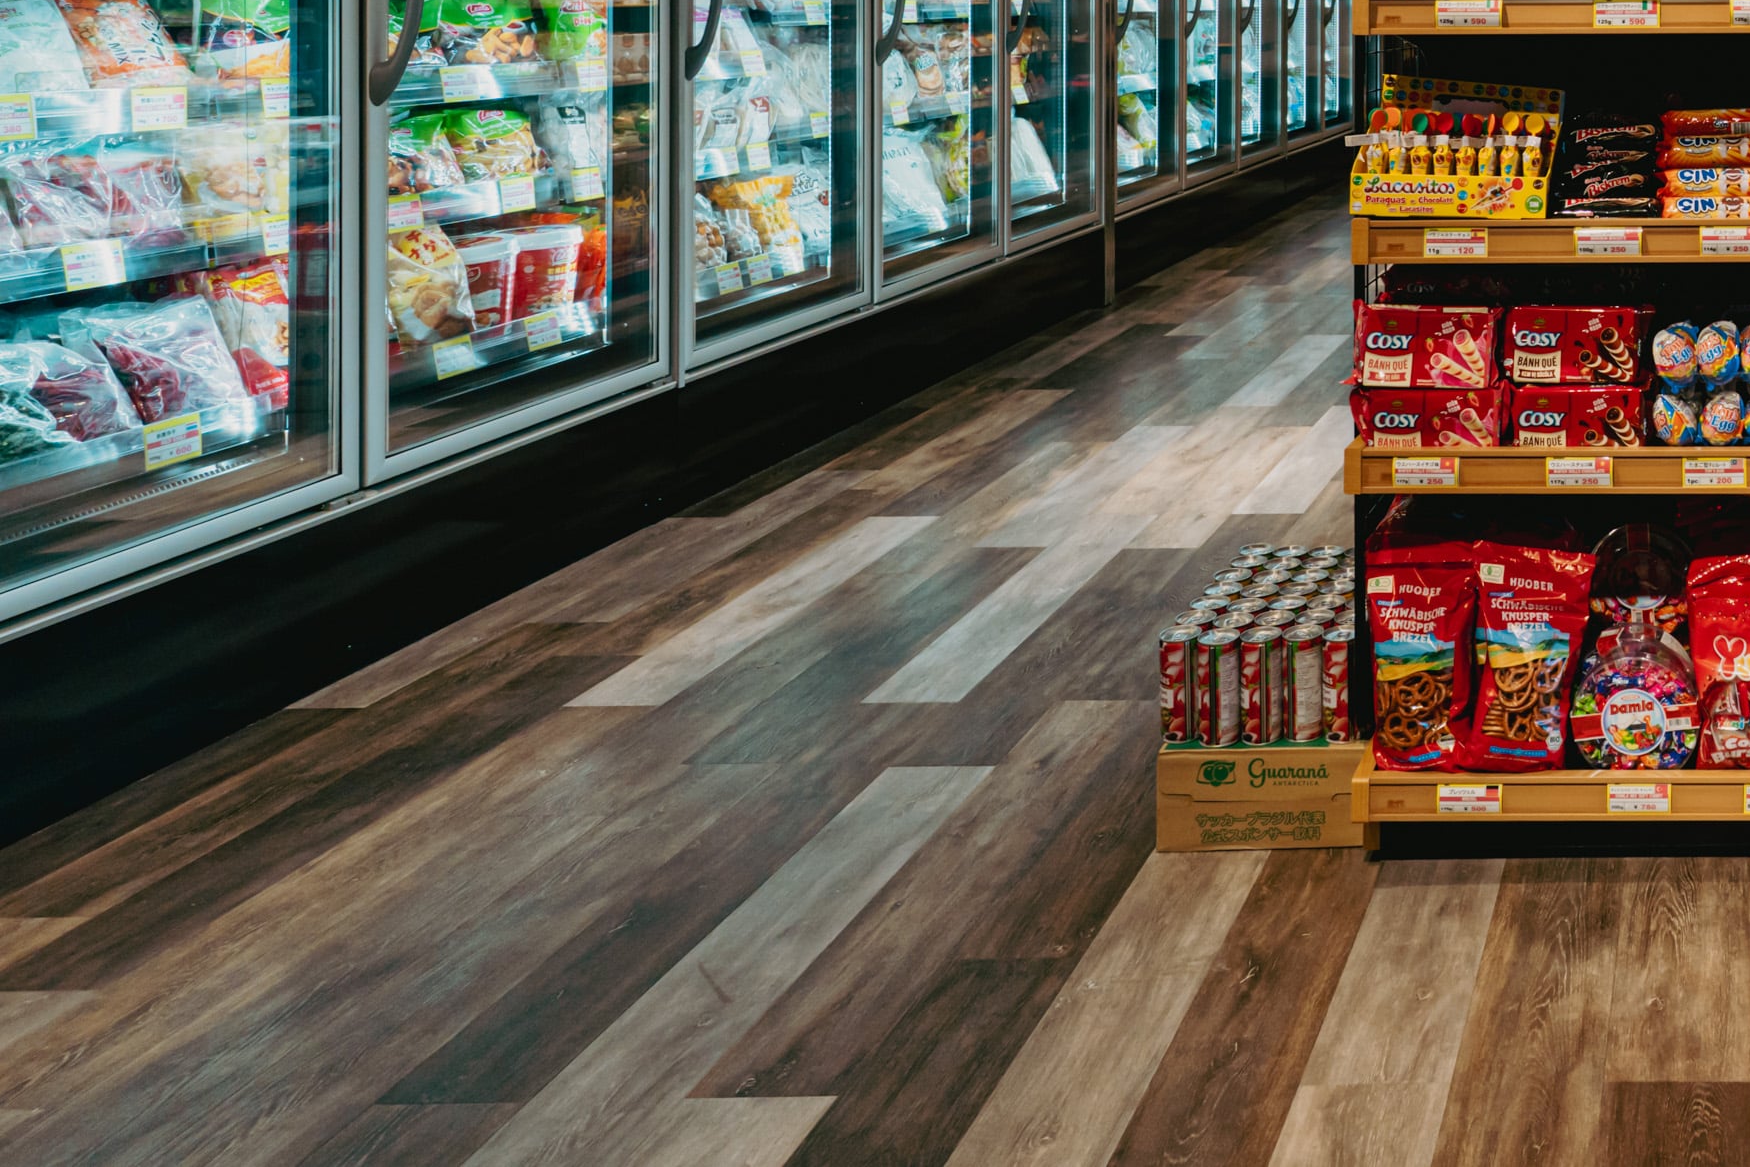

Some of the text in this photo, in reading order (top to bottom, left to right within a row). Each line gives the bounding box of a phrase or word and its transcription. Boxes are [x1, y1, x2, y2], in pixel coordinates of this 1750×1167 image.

[1470, 17, 1487, 25] 590
[1629, 17, 1645, 25] 590
[1363, 177, 1455, 195] Lacasitos
[1365, 195, 1454, 207] Paraguas Chocolate
[1366, 332, 1414, 349] COSY
[1515, 330, 1561, 347] COSY
[1373, 411, 1420, 428] COSY
[1519, 410, 1566, 427] COSY
[1426, 477, 1443, 485] 250
[1582, 477, 1598, 485] 250
[1509, 577, 1554, 592] HUOBER
[1379, 605, 1447, 620] SCHWÄBISCHE
[1501, 611, 1554, 623] KNUSPER-
[1392, 632, 1433, 645] BREZEL
[1609, 699, 1655, 716] Damla
[1248, 758, 1329, 789] Guaraná
[1196, 812, 1326, 827] サッカーブラジル代表
